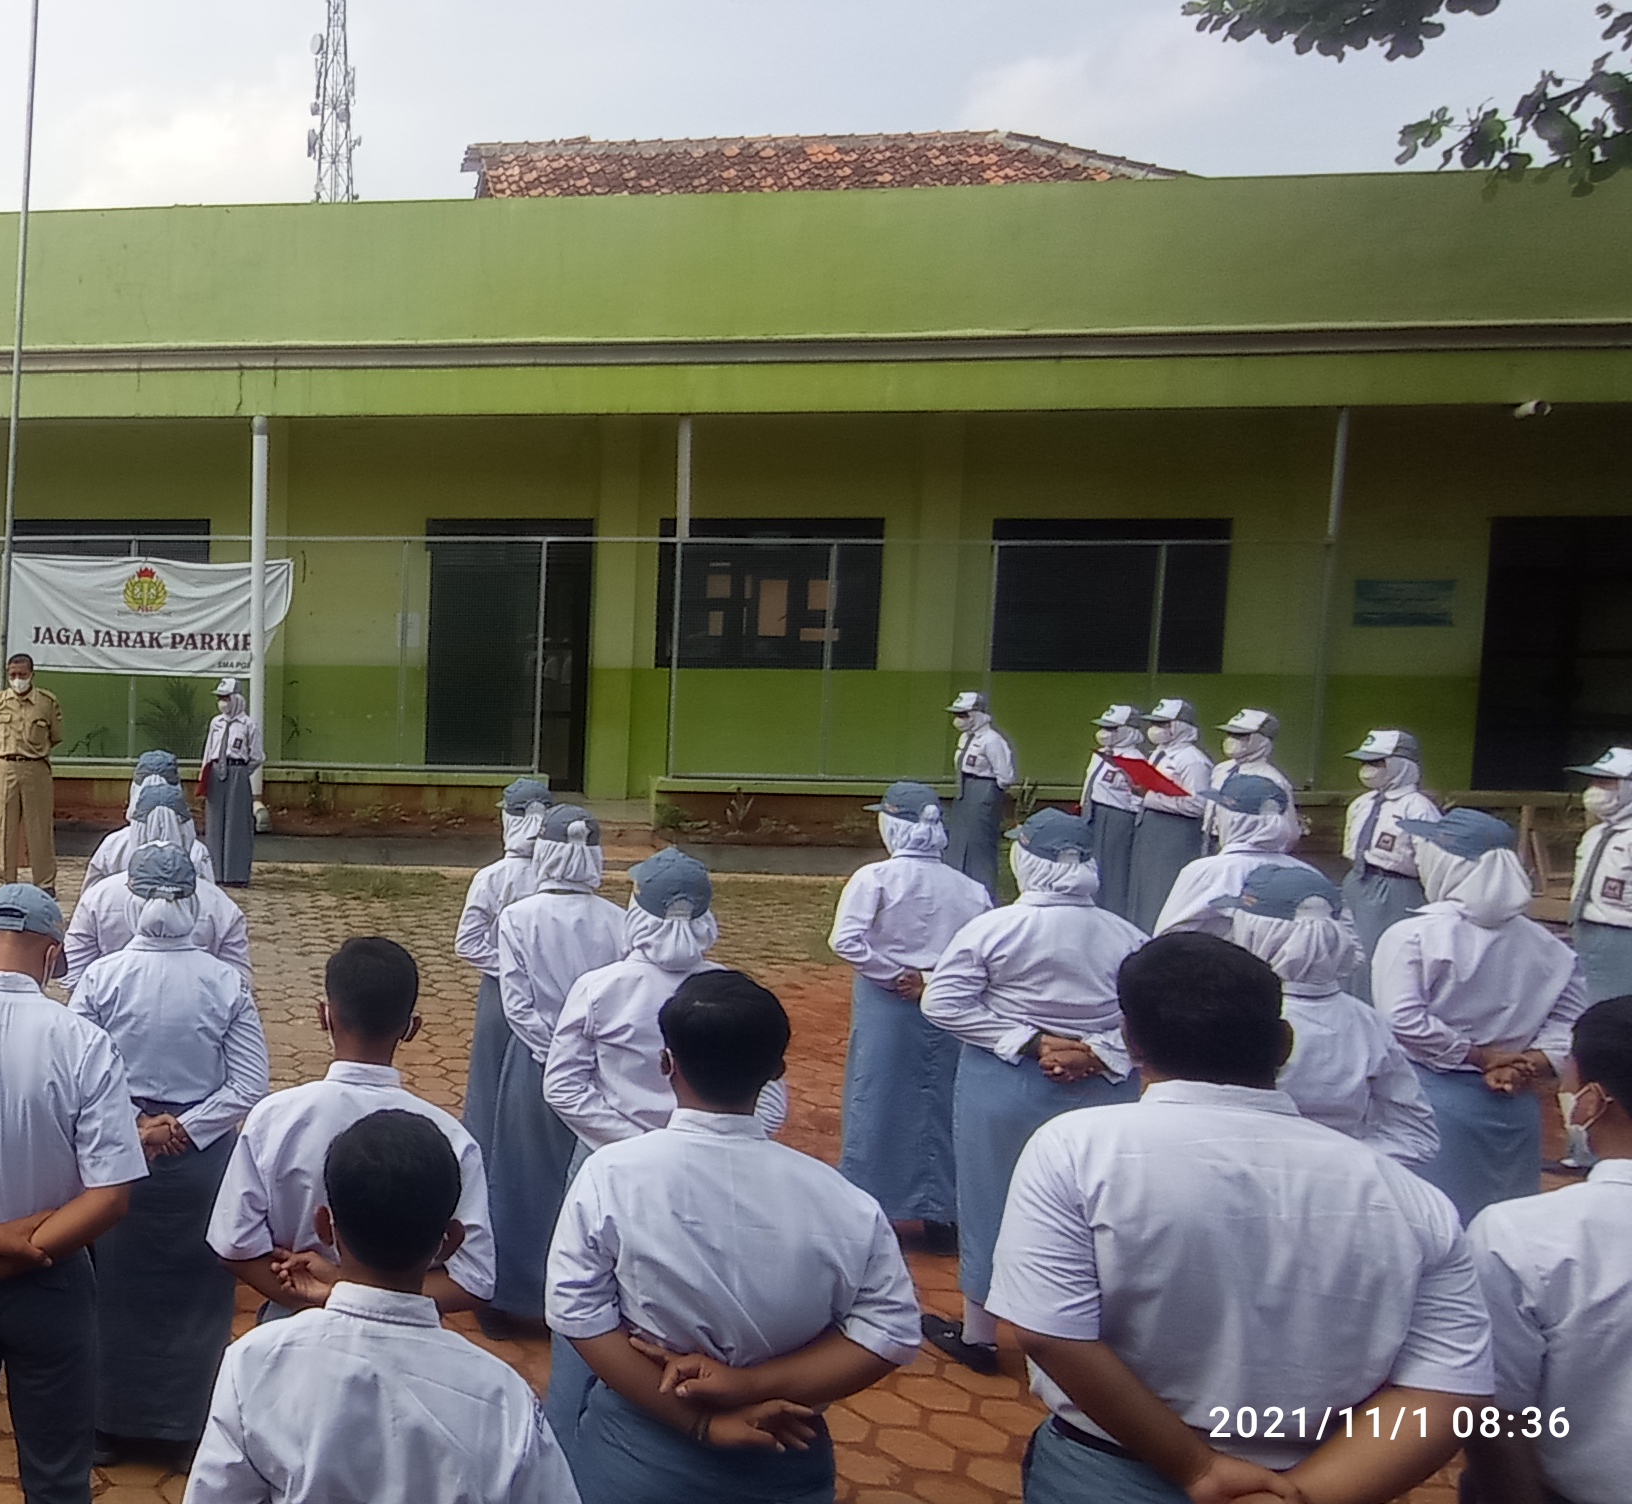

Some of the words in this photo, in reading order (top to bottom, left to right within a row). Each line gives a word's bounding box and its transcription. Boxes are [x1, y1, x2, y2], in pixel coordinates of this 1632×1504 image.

[32, 626, 86, 646] JAGA
[91, 629, 164, 649] JARAK
[217, 661, 235, 669] SMA
